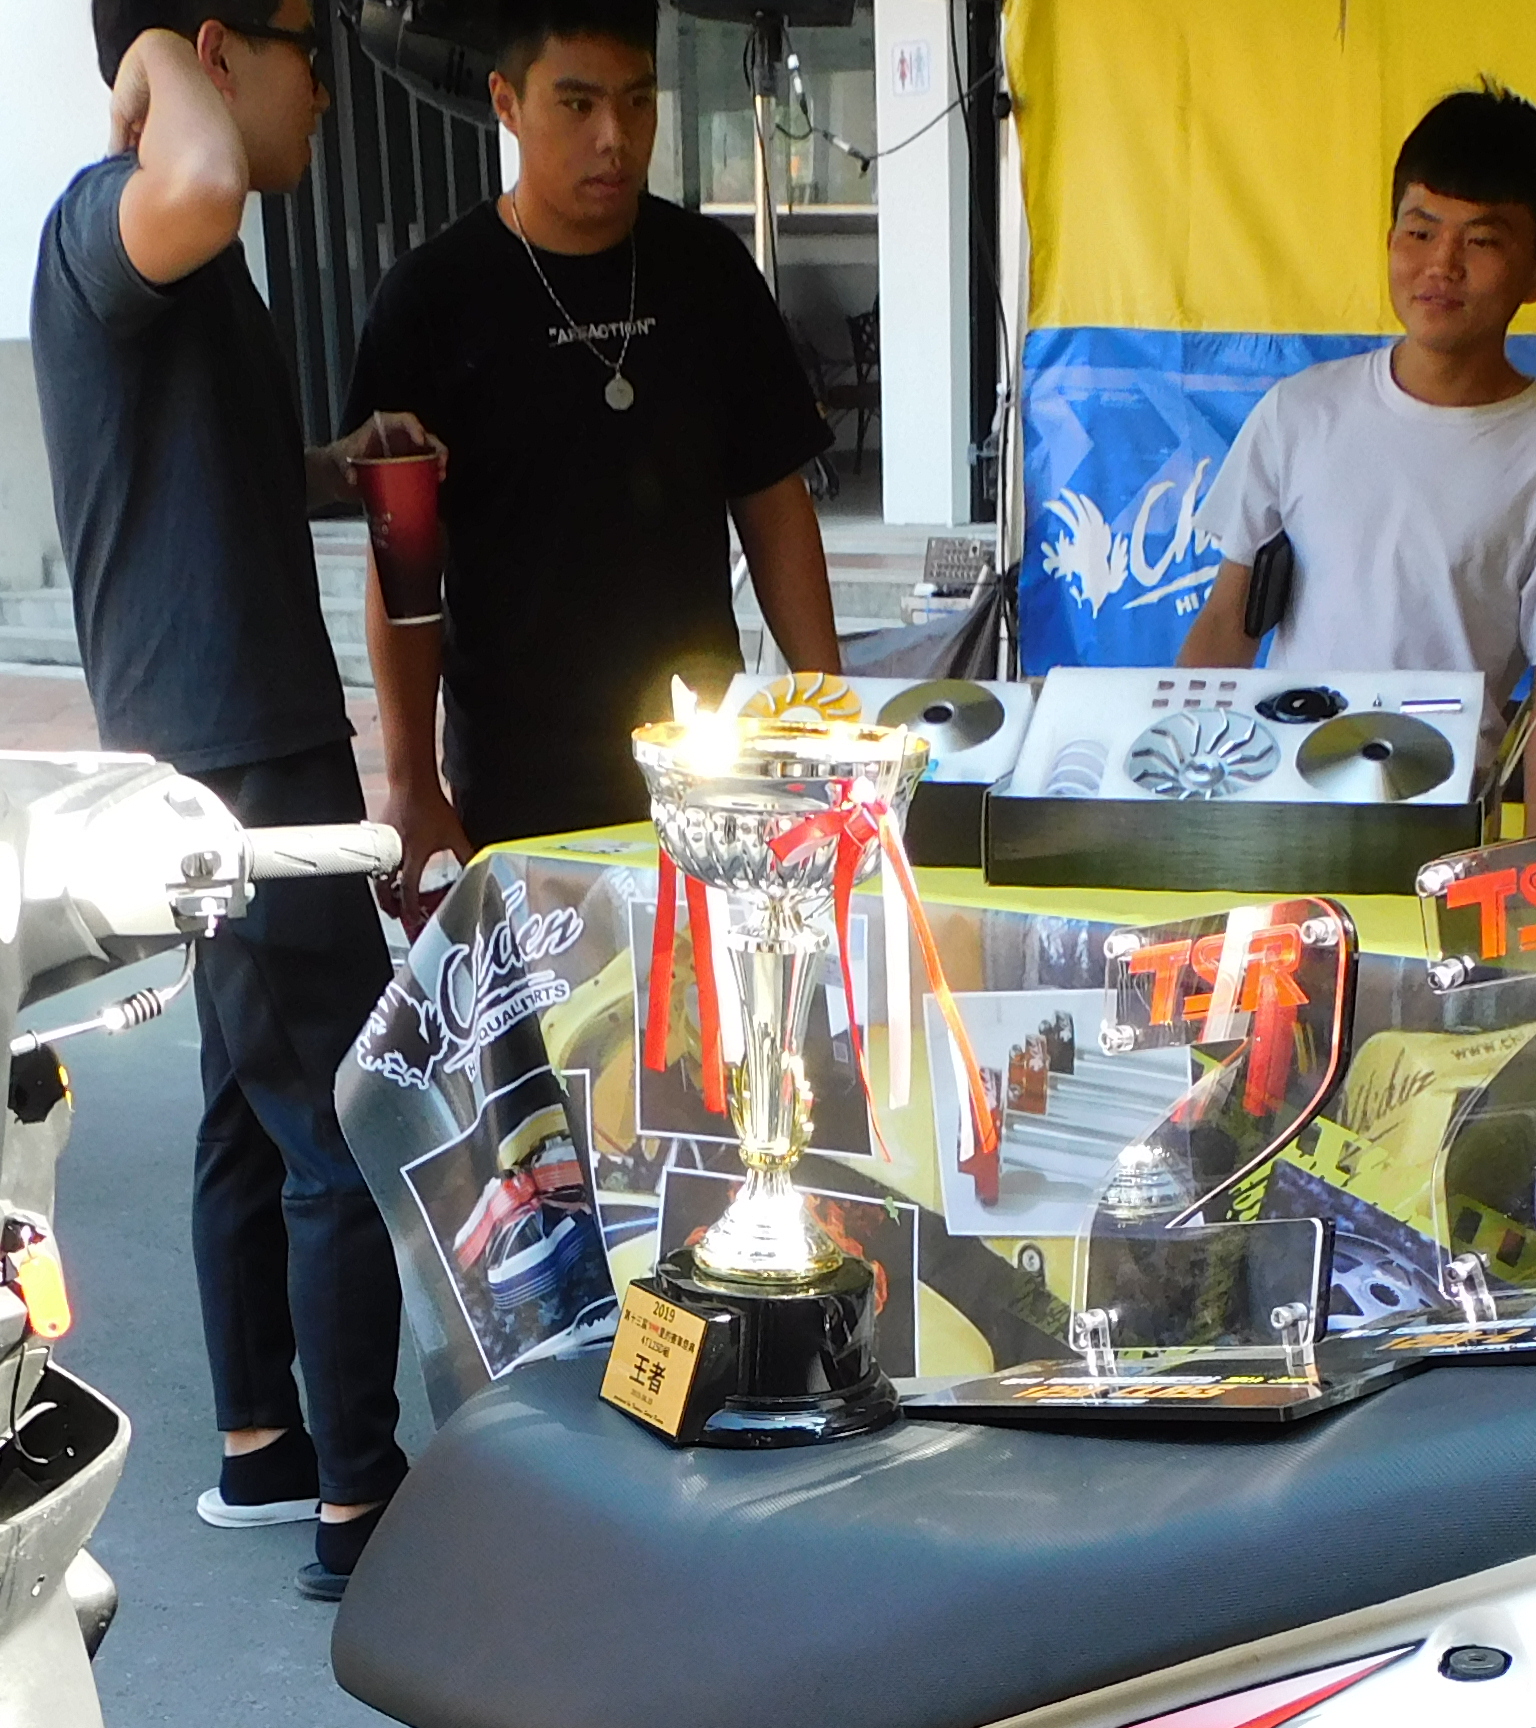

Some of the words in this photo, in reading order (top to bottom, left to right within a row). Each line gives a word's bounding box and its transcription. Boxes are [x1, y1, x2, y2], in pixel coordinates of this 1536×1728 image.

[1176, 593, 1199, 616] HI
[1128, 923, 1310, 1025] TSR
[652, 1301, 676, 1323] 2019
[629, 1352, 667, 1396] 王者
